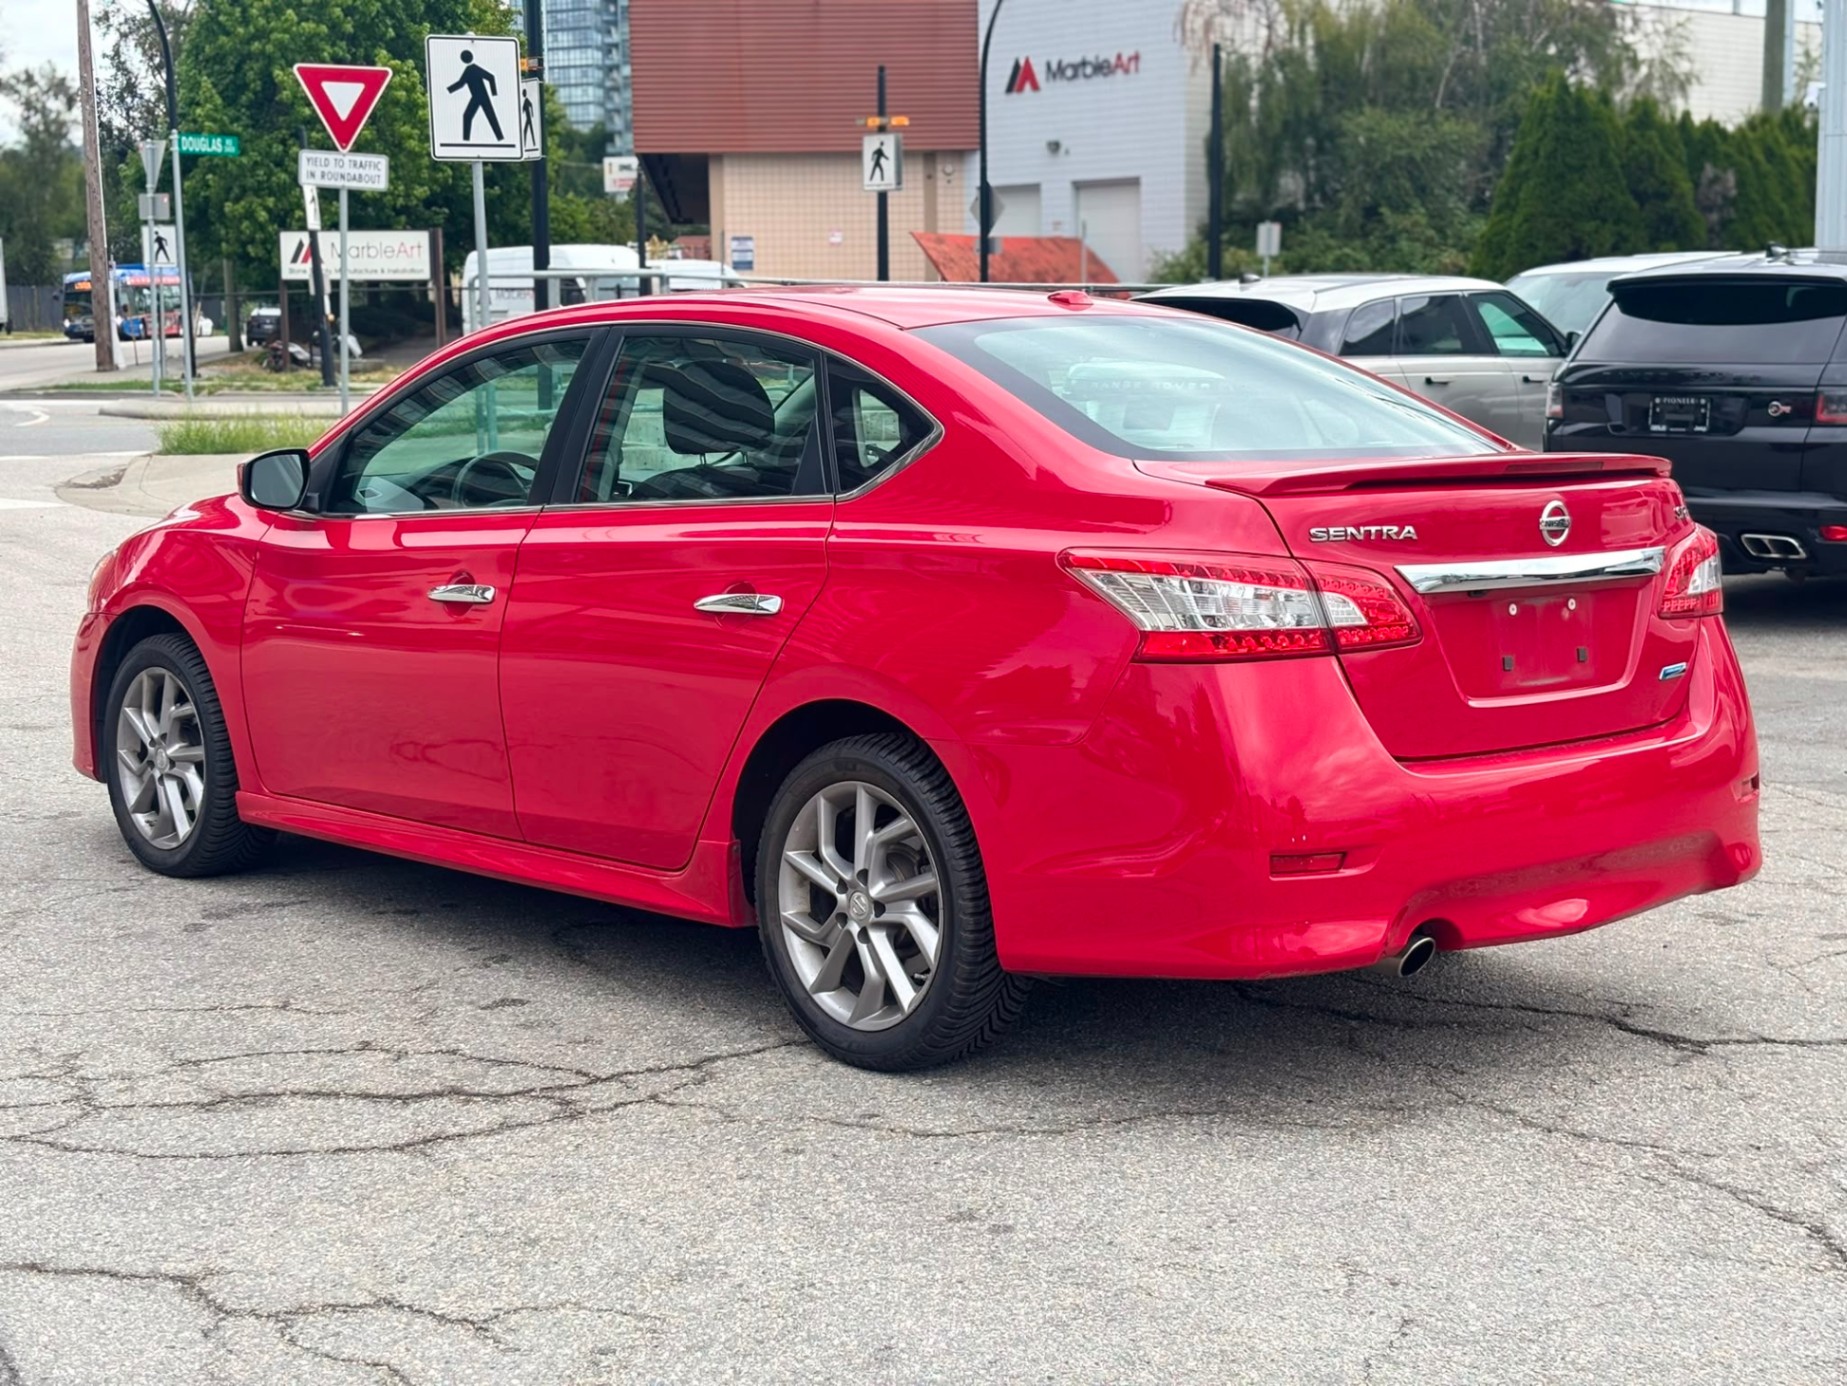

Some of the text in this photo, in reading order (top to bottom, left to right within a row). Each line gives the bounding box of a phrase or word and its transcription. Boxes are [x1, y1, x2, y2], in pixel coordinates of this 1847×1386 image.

[1045, 50, 1140, 83] MarbleArt
[181, 136, 223, 153] DOUGLAS
[306, 156, 382, 172] YIELD TO TRAFFIC
[306, 170, 382, 185] IN ROUNDABOUT
[1309, 525, 1418, 543] SENTRA
